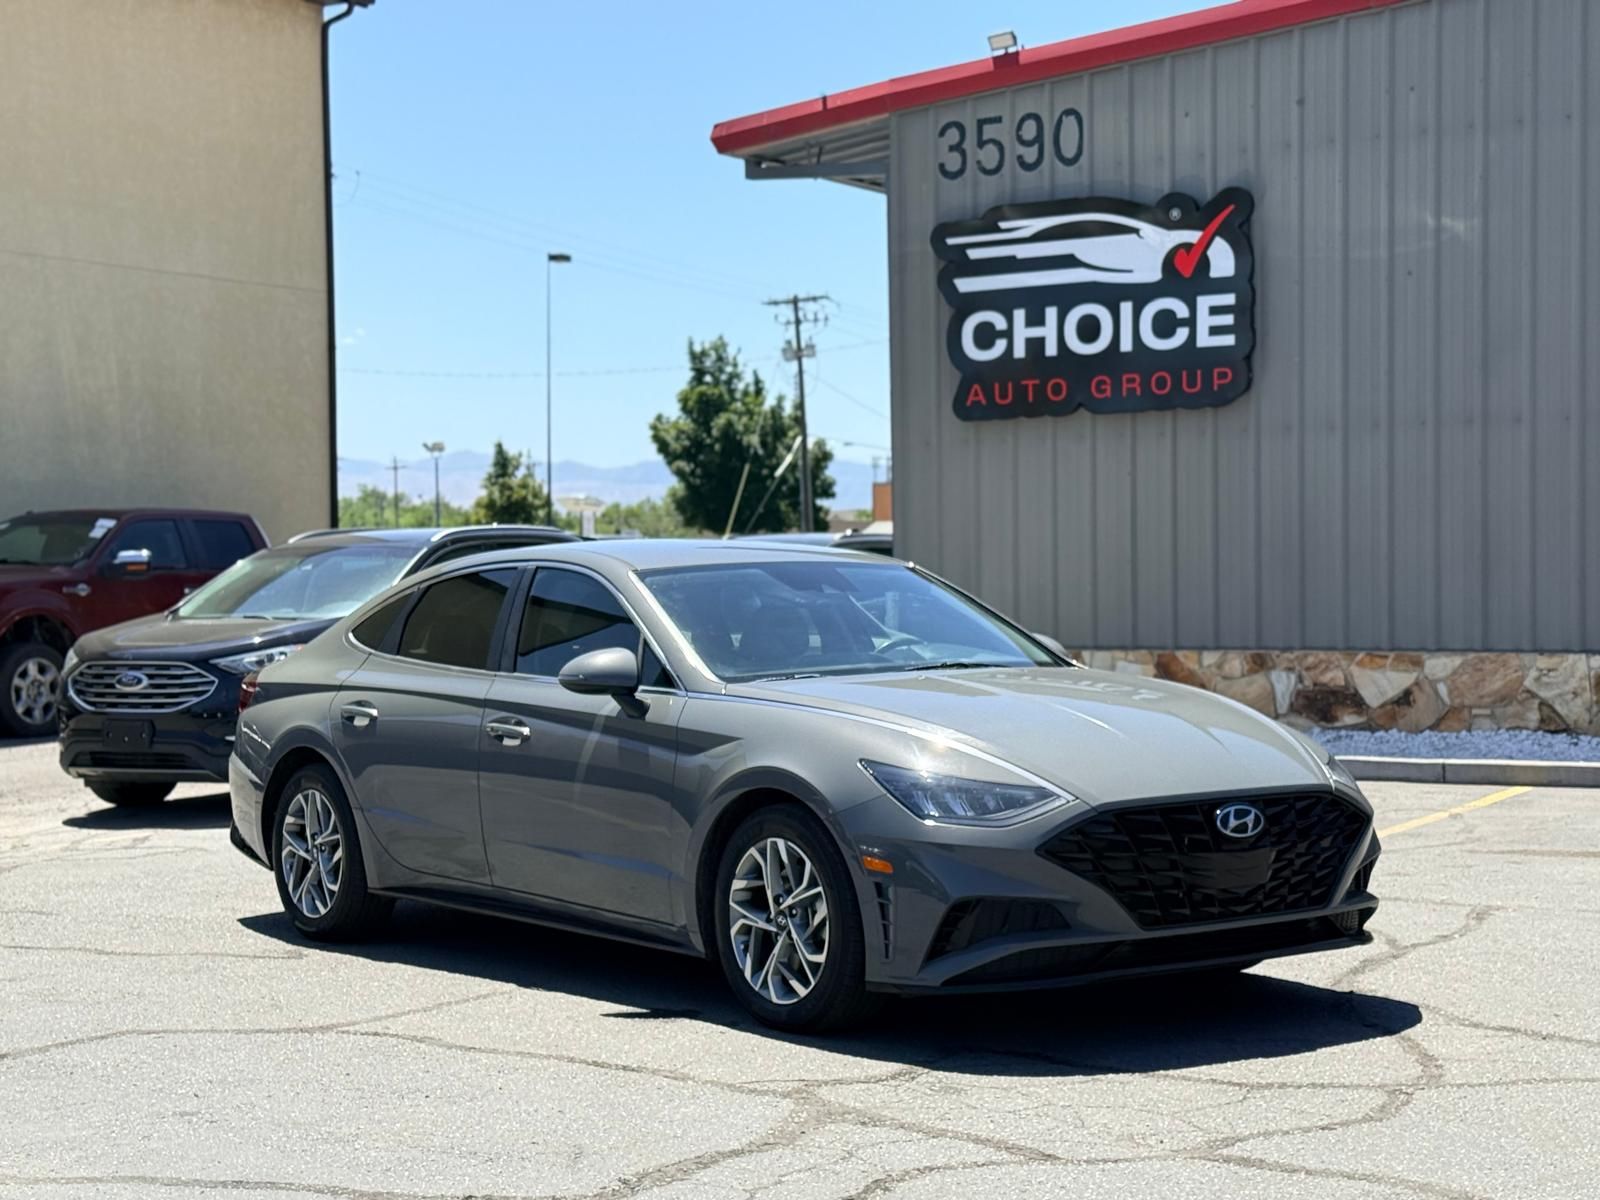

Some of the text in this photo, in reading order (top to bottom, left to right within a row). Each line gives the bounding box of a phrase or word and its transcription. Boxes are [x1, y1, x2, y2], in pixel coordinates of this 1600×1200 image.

[938, 108, 1084, 180] 3590
[961, 293, 1236, 362] CHOICE
[966, 368, 1234, 407] AUTO GROUP
